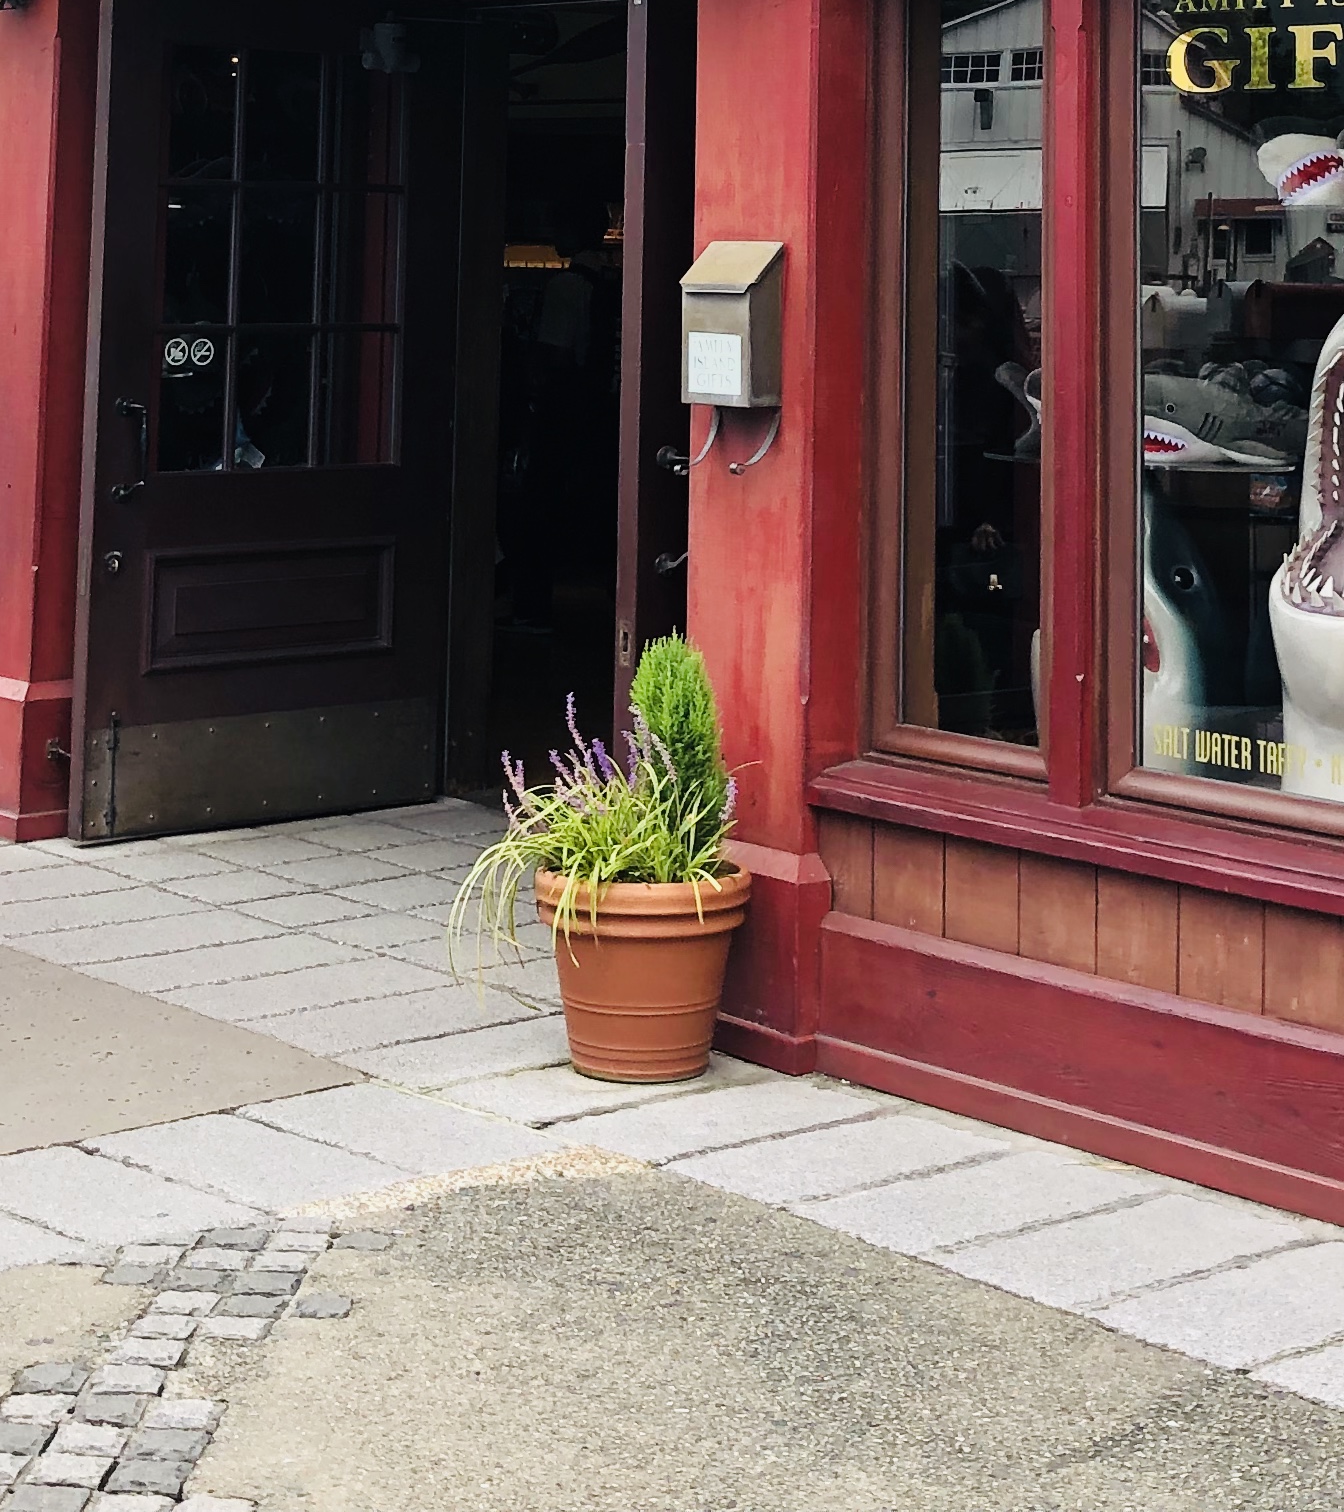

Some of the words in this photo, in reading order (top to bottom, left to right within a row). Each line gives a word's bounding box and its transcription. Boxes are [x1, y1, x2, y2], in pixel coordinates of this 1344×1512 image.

[1154, 726, 1190, 759] SALT
[1194, 729, 1252, 771] WATER
[1257, 739, 1307, 778] TAFFY
